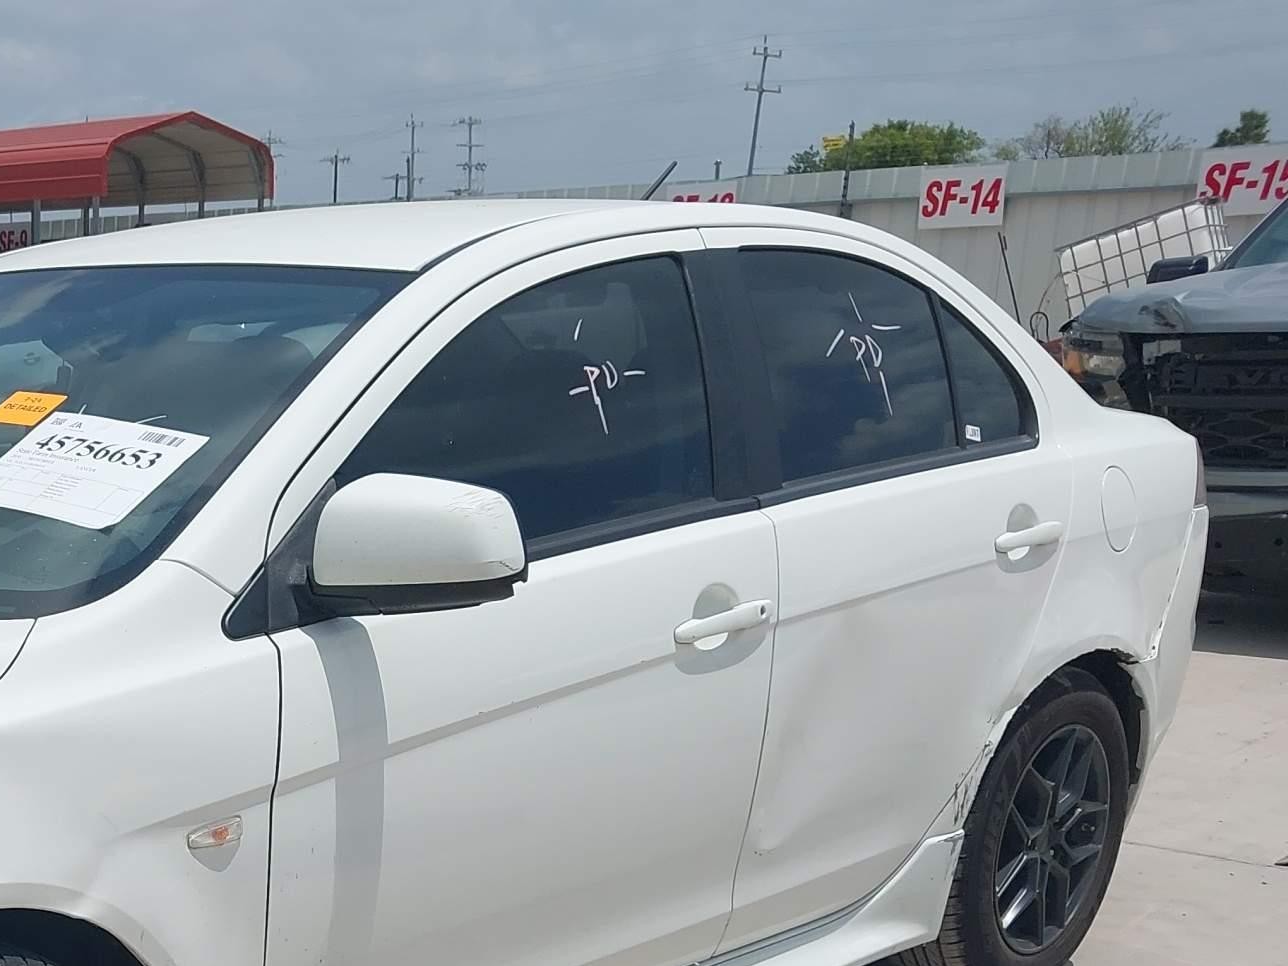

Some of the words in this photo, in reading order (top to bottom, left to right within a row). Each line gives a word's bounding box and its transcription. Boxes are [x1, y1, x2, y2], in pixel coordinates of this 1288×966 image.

[922, 177, 1004, 219] SF-14
[1199, 159, 1288, 203] SF-15
[0, 230, 28, 252] SF-9
[3, 402, 48, 414] DETAILED
[35, 433, 163, 470] 45756653
